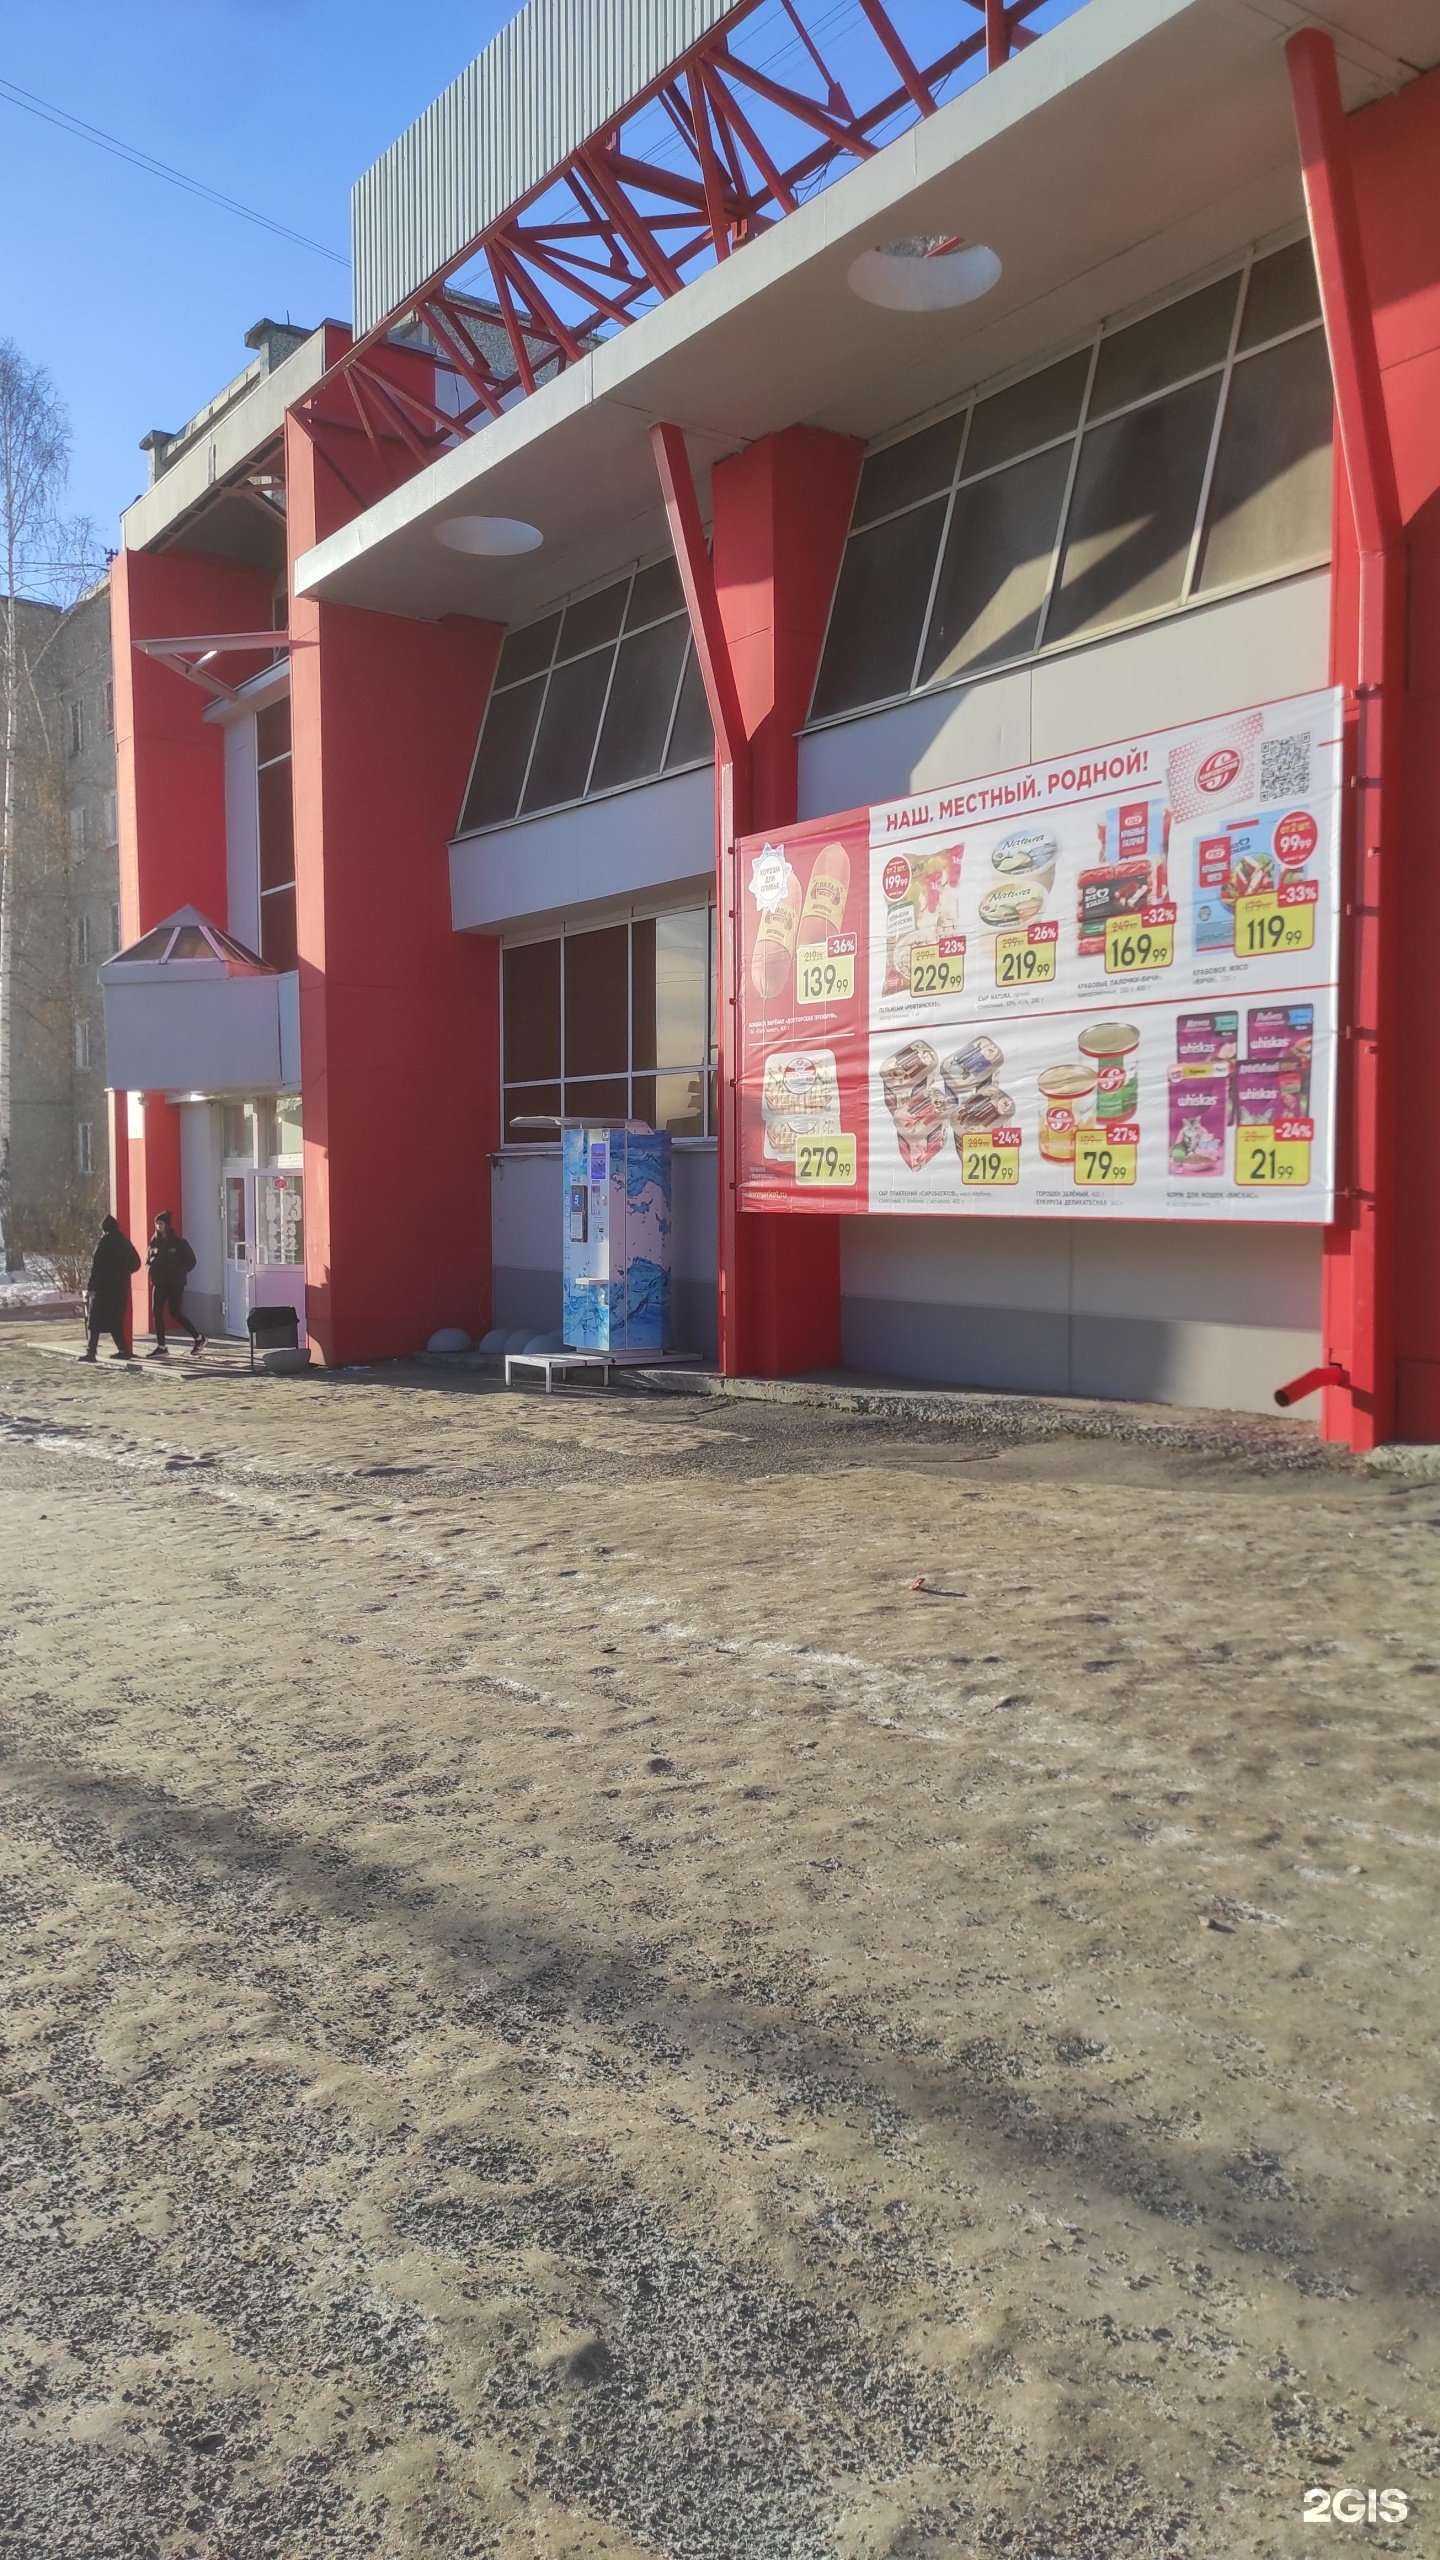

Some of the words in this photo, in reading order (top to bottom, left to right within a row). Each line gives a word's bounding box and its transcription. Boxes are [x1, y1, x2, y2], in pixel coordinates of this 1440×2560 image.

[1047, 748, 1149, 794] РОДНОЙ!
[1002, 834, 1045, 850] Natura
[885, 874, 901, 890] 199
[989, 888, 1031, 902] Natura
[1279, 885, 1317, 903] -33%
[1143, 907, 1175, 924] -32%
[1029, 925, 1057, 940] -26%
[1247, 914, 1285, 950] 119
[1285, 929, 1302, 945] 99
[828, 938, 855, 955] -36%
[940, 940, 965, 955] -23%
[1111, 933, 1152, 968] 169
[1152, 947, 1167, 962] 99
[1002, 950, 1037, 982] 219
[1037, 963, 1050, 977] 99
[803, 964, 837, 998] 139
[836, 978, 849, 993] 99
[913, 962, 950, 993] 229
[949, 975, 962, 988] 99
[1179, 1042, 1216, 1055] whiskas
[1249, 1036, 1291, 1050] whiskas
[1177, 1094, 1218, 1107] whiskas
[1238, 1087, 1279, 1101] whiskas
[993, 1131, 1020, 1145] -24%
[1107, 1127, 1138, 1142] -27%
[1275, 1121, 1313, 1139] -24%
[800, 1145, 839, 1177] 279
[838, 1162, 851, 1177] 99
[967, 1152, 1002, 1180] 219
[1001, 1167, 1014, 1179] 99
[1083, 1150, 1112, 1180] 79
[1112, 1166, 1127, 1178] 99
[1250, 1148, 1276, 1179] 21
[1277, 1165, 1294, 1179] 99
